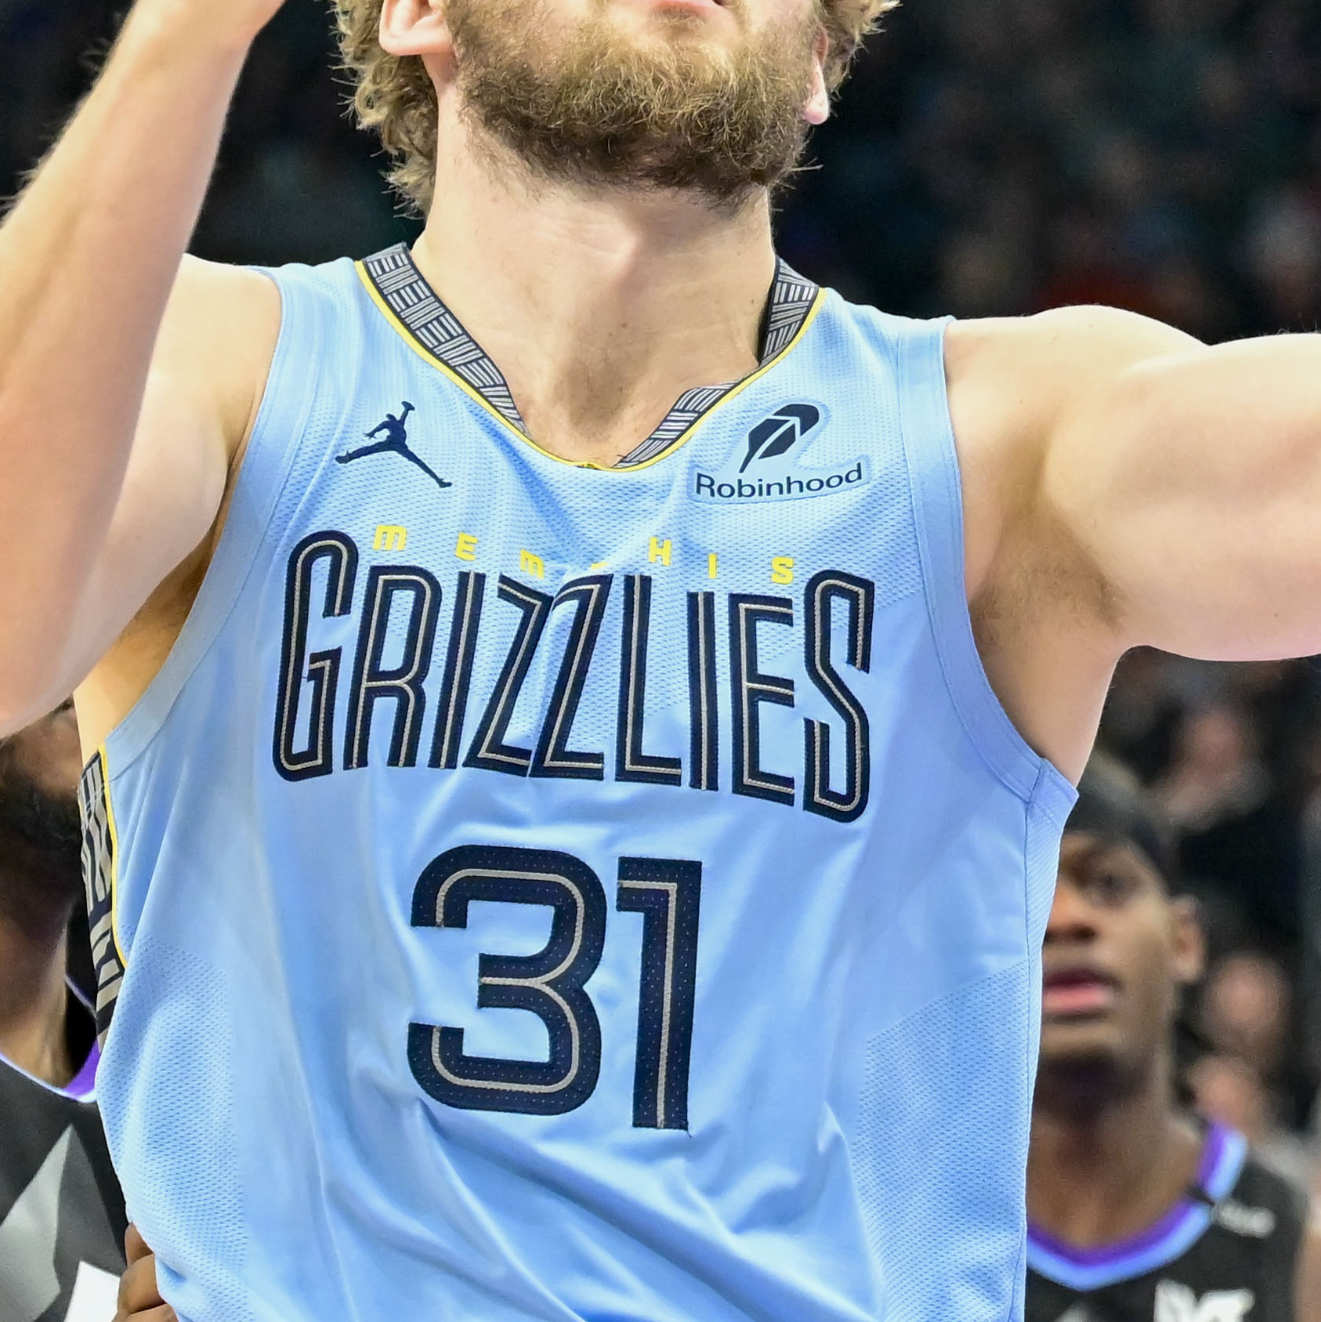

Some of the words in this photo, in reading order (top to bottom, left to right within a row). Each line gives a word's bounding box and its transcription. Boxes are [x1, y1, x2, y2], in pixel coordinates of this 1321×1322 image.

[372, 524, 794, 584] MEMHIS
[695, 461, 862, 498] Robinhood
[273, 530, 874, 822] GRIZZLIES
[407, 844, 702, 1131] 31
